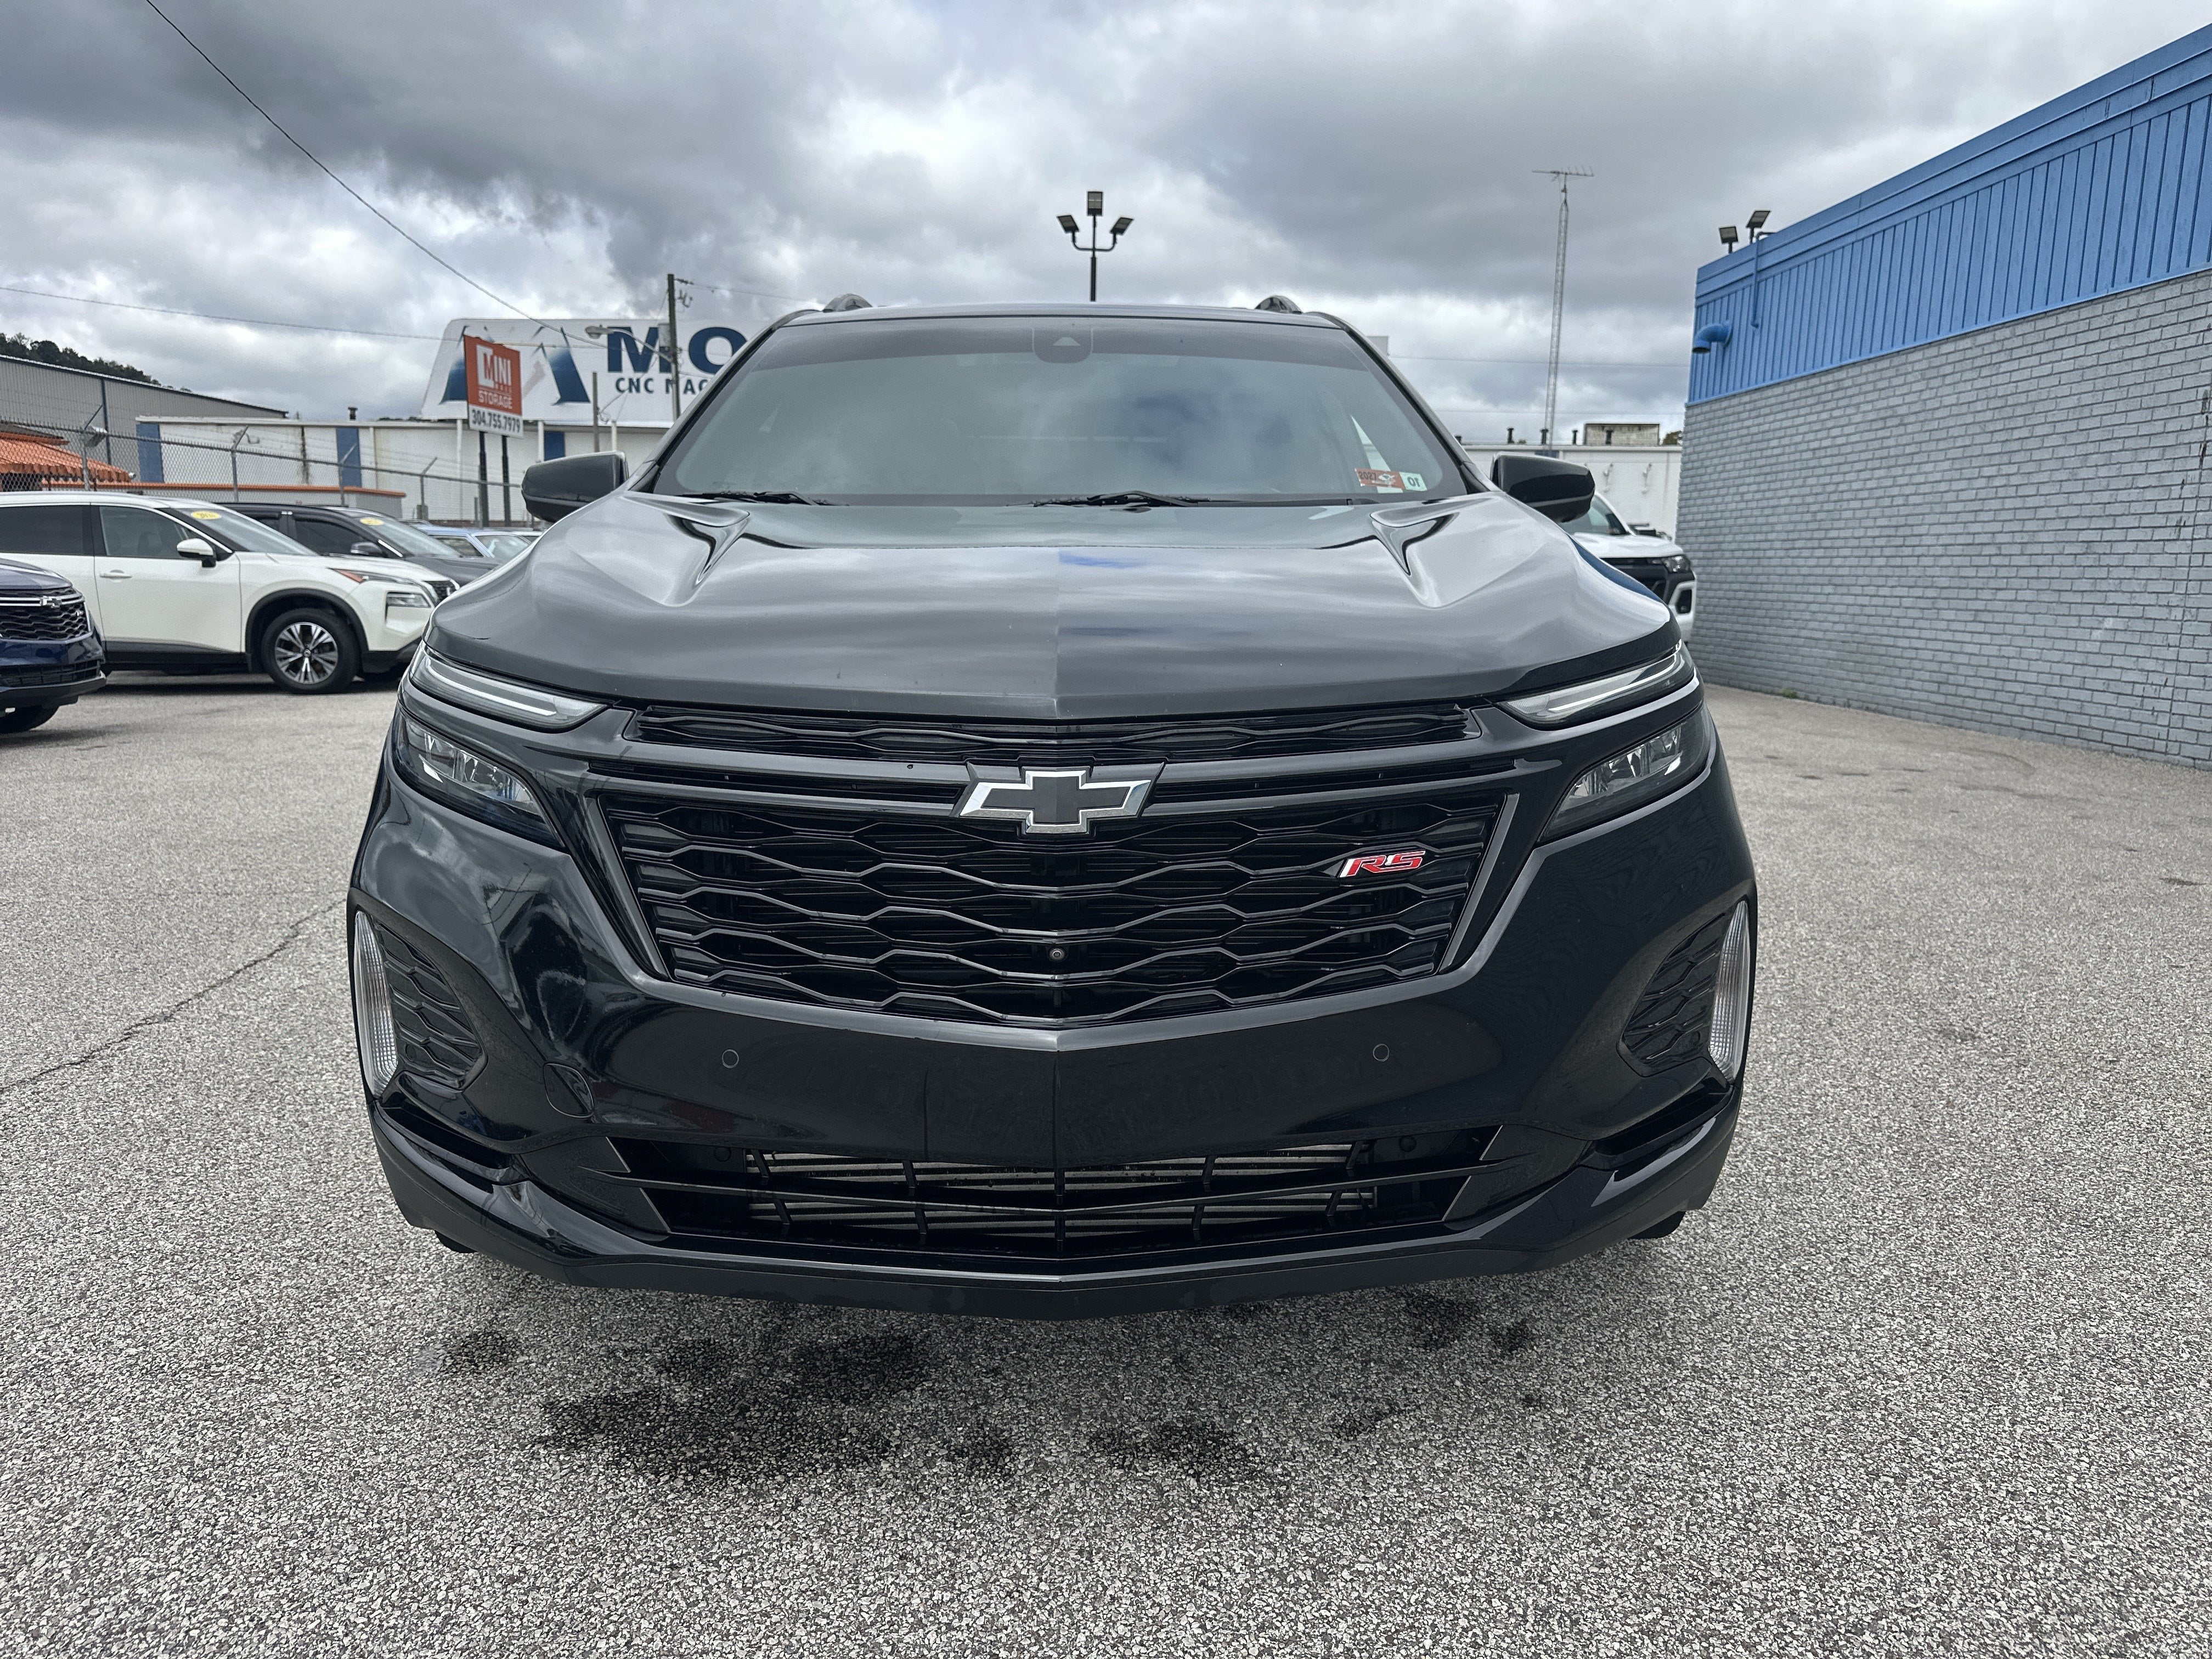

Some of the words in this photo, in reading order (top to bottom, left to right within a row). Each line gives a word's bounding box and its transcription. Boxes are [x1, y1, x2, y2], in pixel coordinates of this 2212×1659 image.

[481, 350, 511, 386] MINI
[616, 378, 654, 393] CNC
[478, 389, 512, 410] STORAGE
[1407, 476, 1420, 487] 01
[1338, 851, 1426, 878] RS
